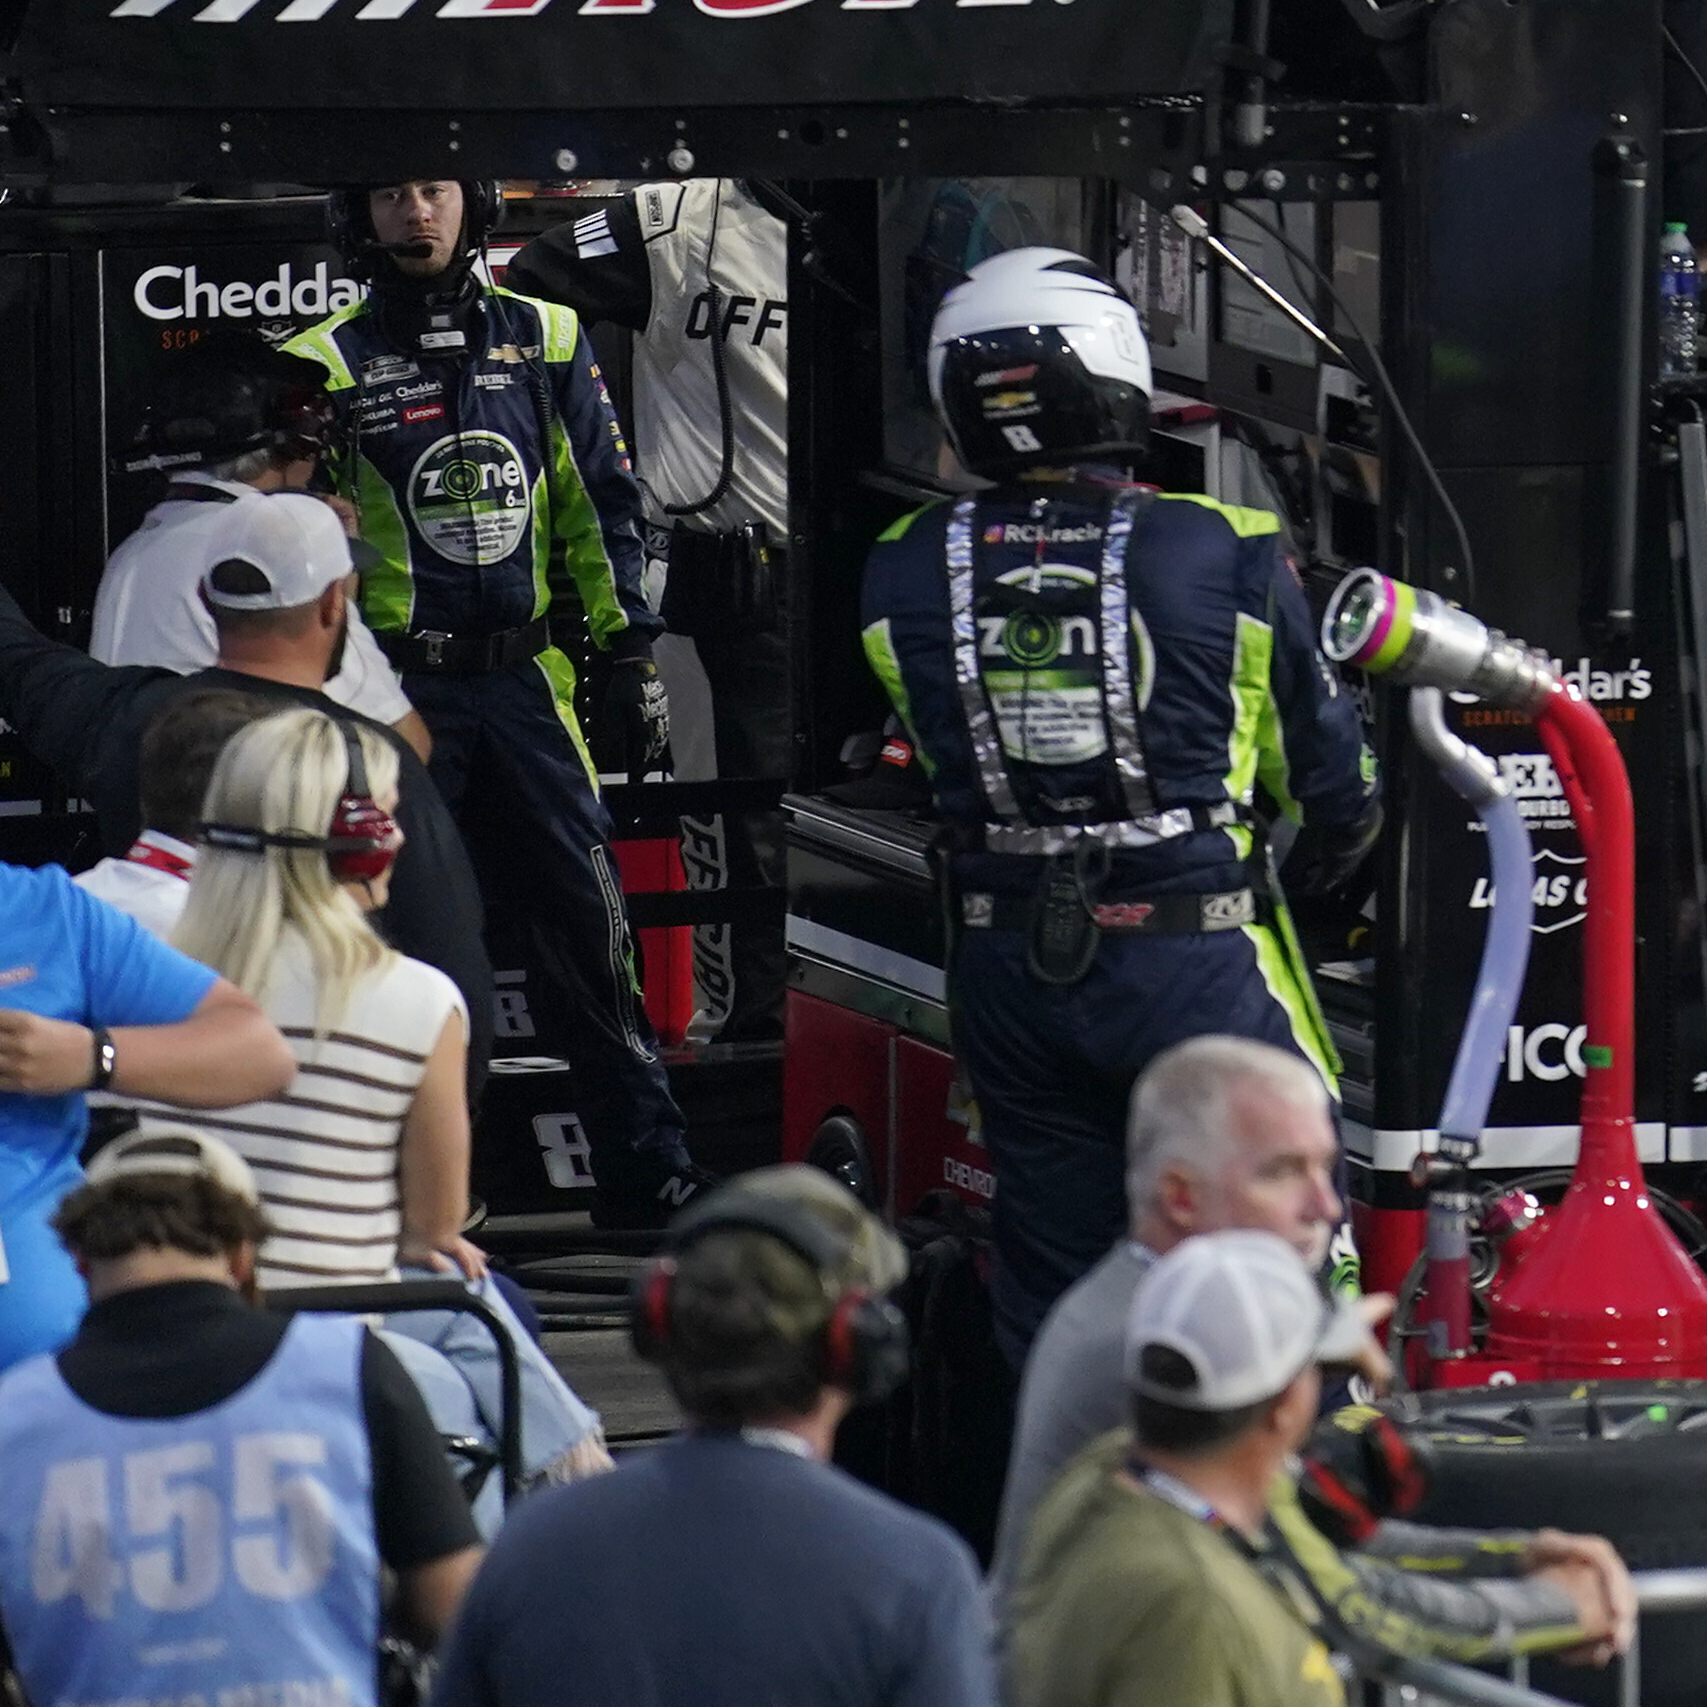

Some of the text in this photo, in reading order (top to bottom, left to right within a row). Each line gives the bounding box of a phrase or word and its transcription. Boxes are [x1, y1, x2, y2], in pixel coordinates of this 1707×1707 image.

[406, 407, 442, 420] Lenovo
[420, 459, 520, 500] zone
[976, 610, 1097, 667] zon
[31, 1432, 337, 1621] 455
